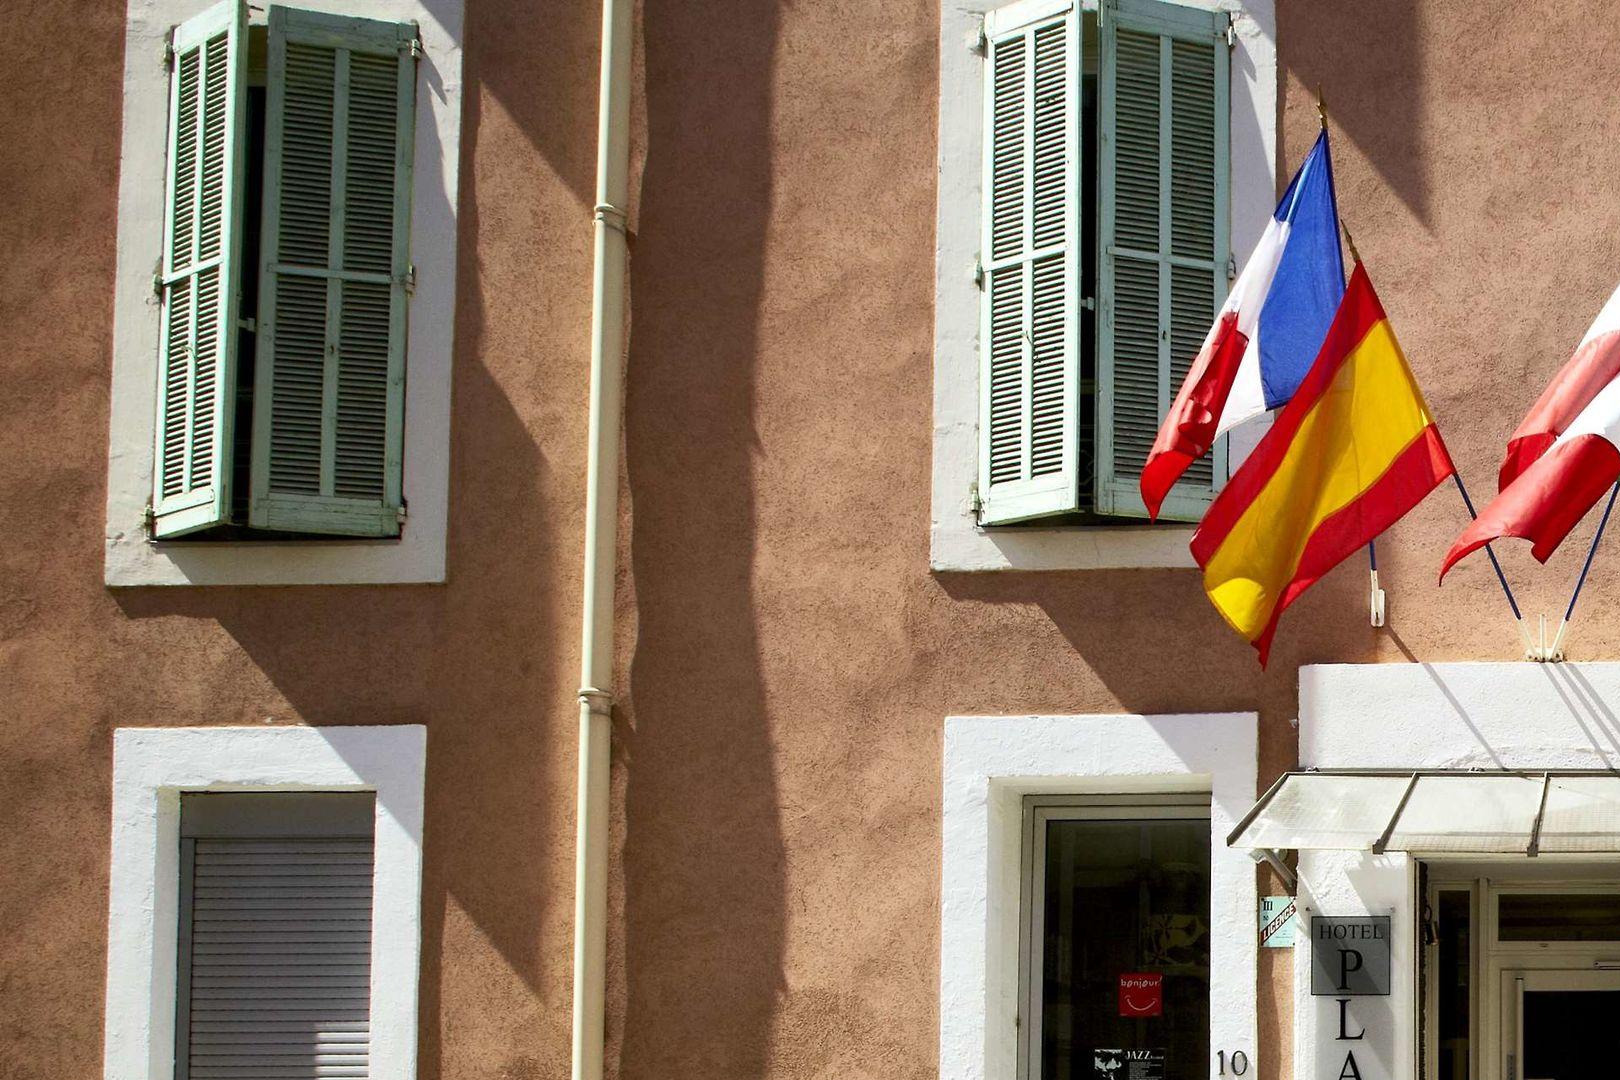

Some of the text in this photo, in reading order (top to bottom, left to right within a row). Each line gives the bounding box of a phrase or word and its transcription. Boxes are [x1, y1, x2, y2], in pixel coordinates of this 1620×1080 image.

[1263, 904, 1297, 941] LICENCE
[1320, 924, 1384, 940] HOTEL
[1125, 1050, 1151, 1060] JAZZ
[1217, 1050, 1249, 1076] 10
